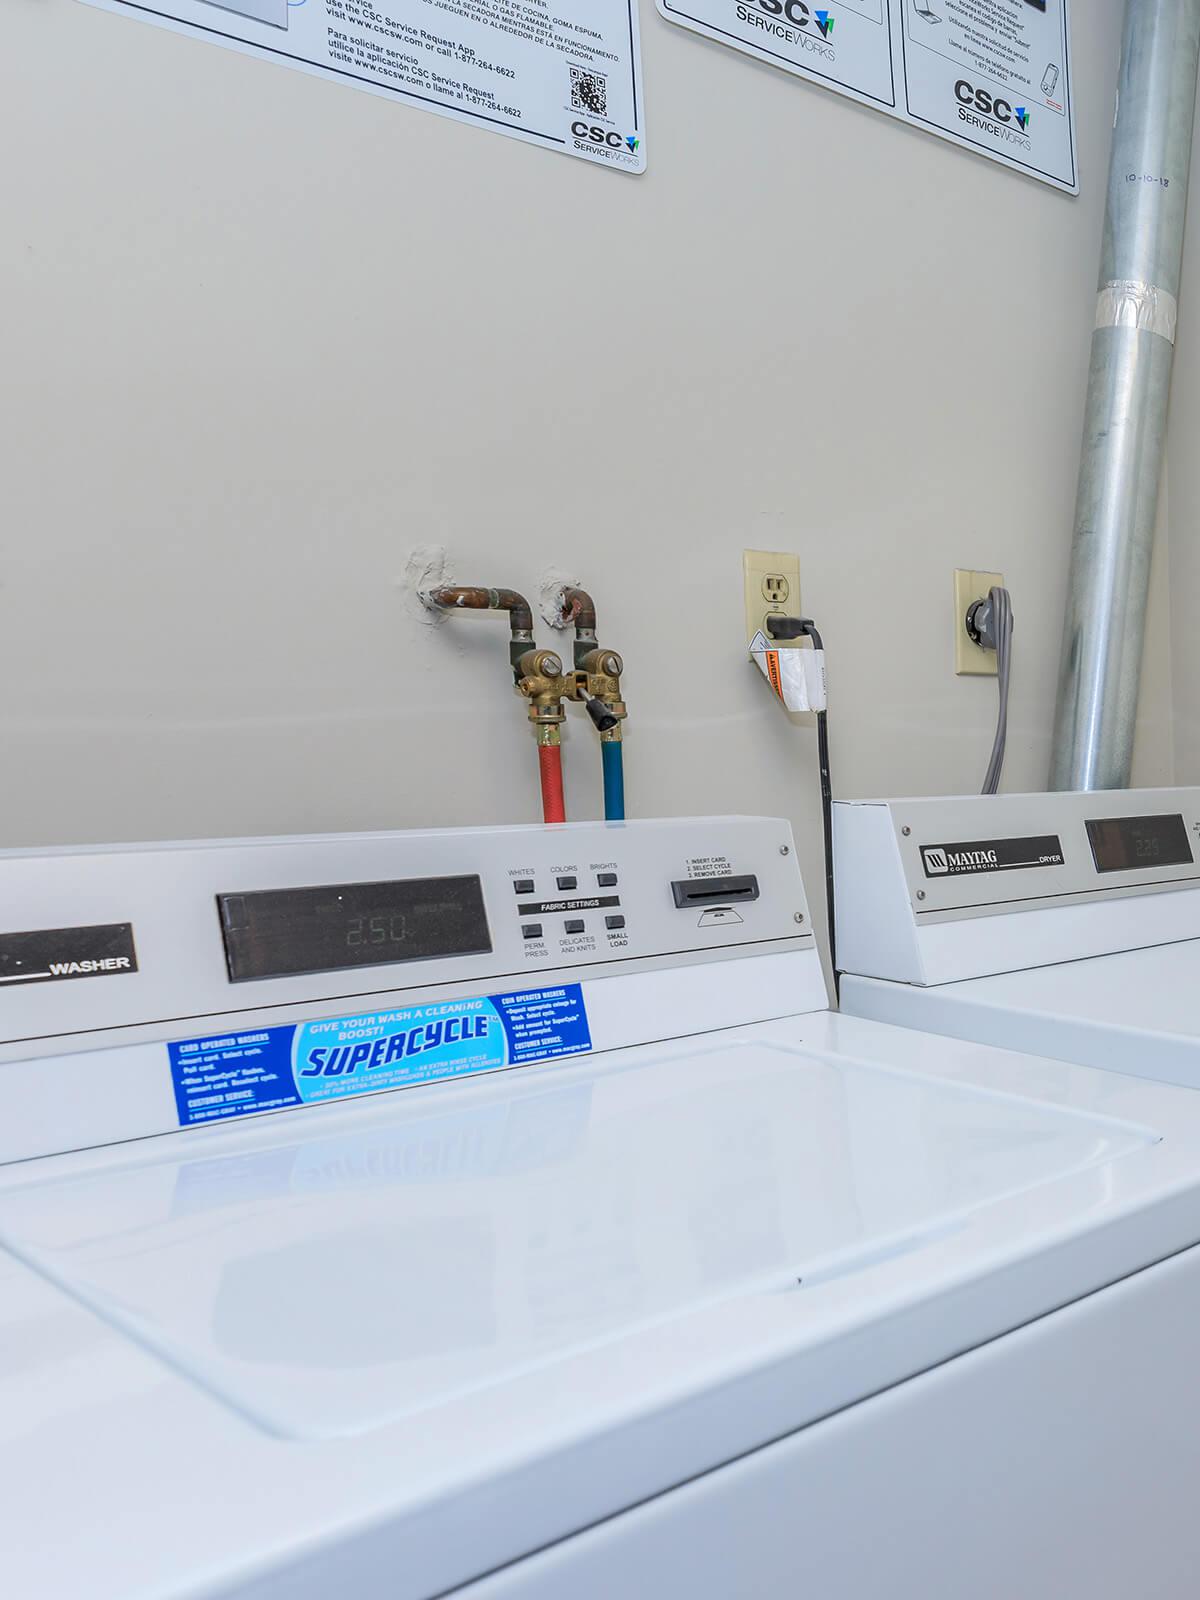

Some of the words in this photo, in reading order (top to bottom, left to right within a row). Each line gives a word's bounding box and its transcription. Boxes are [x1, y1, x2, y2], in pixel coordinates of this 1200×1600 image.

[434, 1, 469, 18] JUEGUEN
[471, 13, 480, 22] EN
[490, 20, 533, 41] ALREDEDOR
[546, 40, 555, 48] LA
[462, 2, 500, 20] SECADORA
[501, 16, 535, 32] MIENTRAS
[554, 34, 563, 43] EN
[500, 7, 515, 17] GAS
[511, 3, 521, 11] DE
[553, 17, 573, 30] GOMA
[746, 0, 809, 26] SC
[326, 7, 346, 20] visit
[348, 15, 423, 48] www.cscsw.com
[425, 43, 434, 51] or
[436, 46, 452, 58] call
[454, 52, 515, 79] 1-877-264-6622
[345, 3, 360, 15] the
[362, 9, 382, 23] CSC
[385, 17, 418, 36] Service
[420, 30, 456, 50] Request
[458, 43, 475, 57] App
[736, 5, 836, 62] SERVICEWORKS
[327, 27, 347, 41] Para
[350, 35, 384, 53] solicitar
[386, 48, 418, 66] servicio
[328, 40, 354, 54] utilice
[357, 48, 365, 57] la
[367, 51, 409, 72] aplicación
[411, 67, 429, 79] CSC
[431, 72, 460, 90] Service
[462, 82, 495, 101] Request
[328, 50, 352, 63] visite
[354, 58, 423, 87] www.cscsw.com
[433, 83, 454, 97] llame
[456, 90, 463, 99] al
[465, 94, 521, 118] 1-877-264-6622
[954, 80, 1011, 122] CSC
[571, 121, 622, 147] CSC
[958, 108, 1031, 151] SERVICEWORKS
[573, 140, 640, 166] SERVICEWORKS
[508, 868, 535, 876] WHITES
[550, 865, 578, 873] COLORS
[589, 862, 618, 871] BRIGHTS
[947, 850, 997, 866] MAYTAG
[949, 863, 999, 872] COMMERCIAL
[1039, 855, 1062, 863] DRYER
[541, 902, 567, 911] FABRIC
[567, 899, 600, 909] SETTINGS
[524, 942, 545, 950] PERM
[559, 936, 595, 946] DELICATES
[561, 945, 575, 954] AND
[576, 944, 596, 952] KNITS
[607, 933, 628, 941] SMALL
[610, 940, 628, 948] LOAD
[50, 957, 130, 976] WASHER
[525, 950, 549, 958] PRESS
[310, 1022, 339, 1034] GIVE
[342, 1016, 375, 1029] YOUR
[378, 1011, 411, 1024] WASH
[414, 1010, 423, 1019] A
[425, 1000, 483, 1016] CLEANING
[338, 1026, 384, 1040] BOOST!
[300, 1015, 488, 1078] SUPERCYCLE
